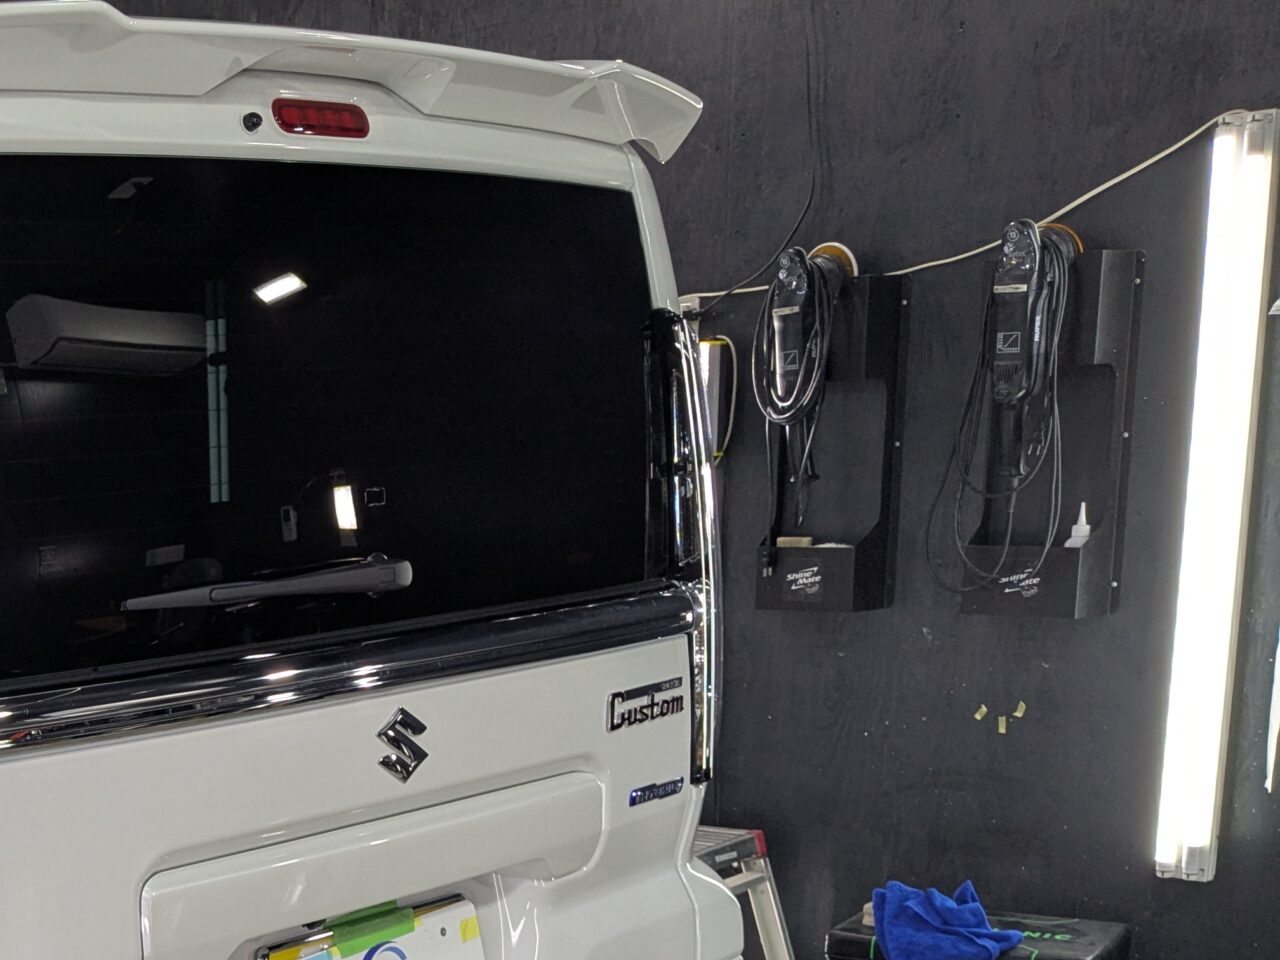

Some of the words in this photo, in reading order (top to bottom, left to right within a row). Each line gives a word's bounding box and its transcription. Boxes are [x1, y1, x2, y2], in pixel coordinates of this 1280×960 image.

[786, 569, 813, 582] Shine
[797, 575, 822, 585] Mate
[607, 690, 685, 732] Custom
